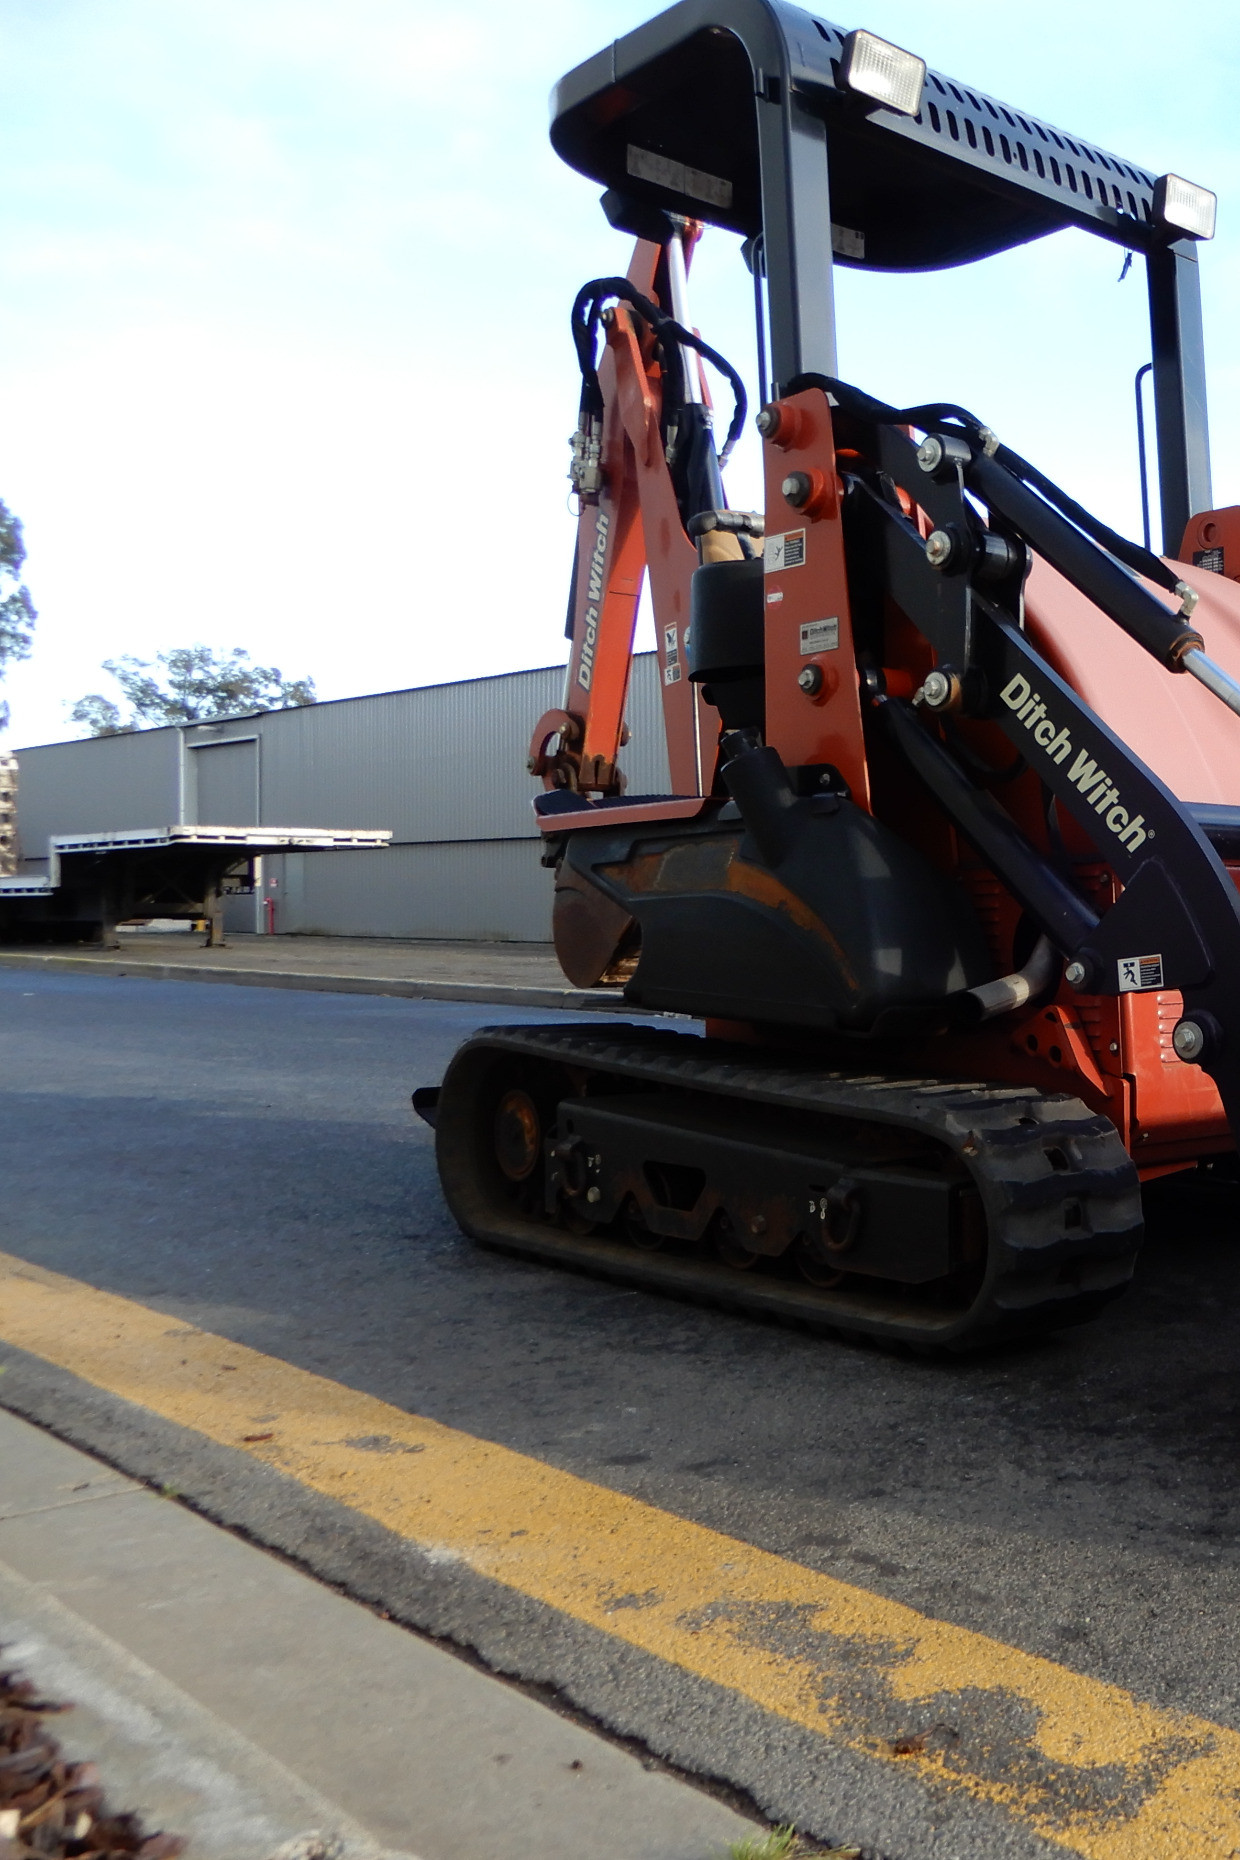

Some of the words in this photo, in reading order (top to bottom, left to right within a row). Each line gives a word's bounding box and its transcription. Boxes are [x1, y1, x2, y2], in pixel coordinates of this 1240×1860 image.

[588, 513, 610, 602] Witch
[578, 605, 599, 690] Ditch
[1000, 672, 1072, 765] Ditch
